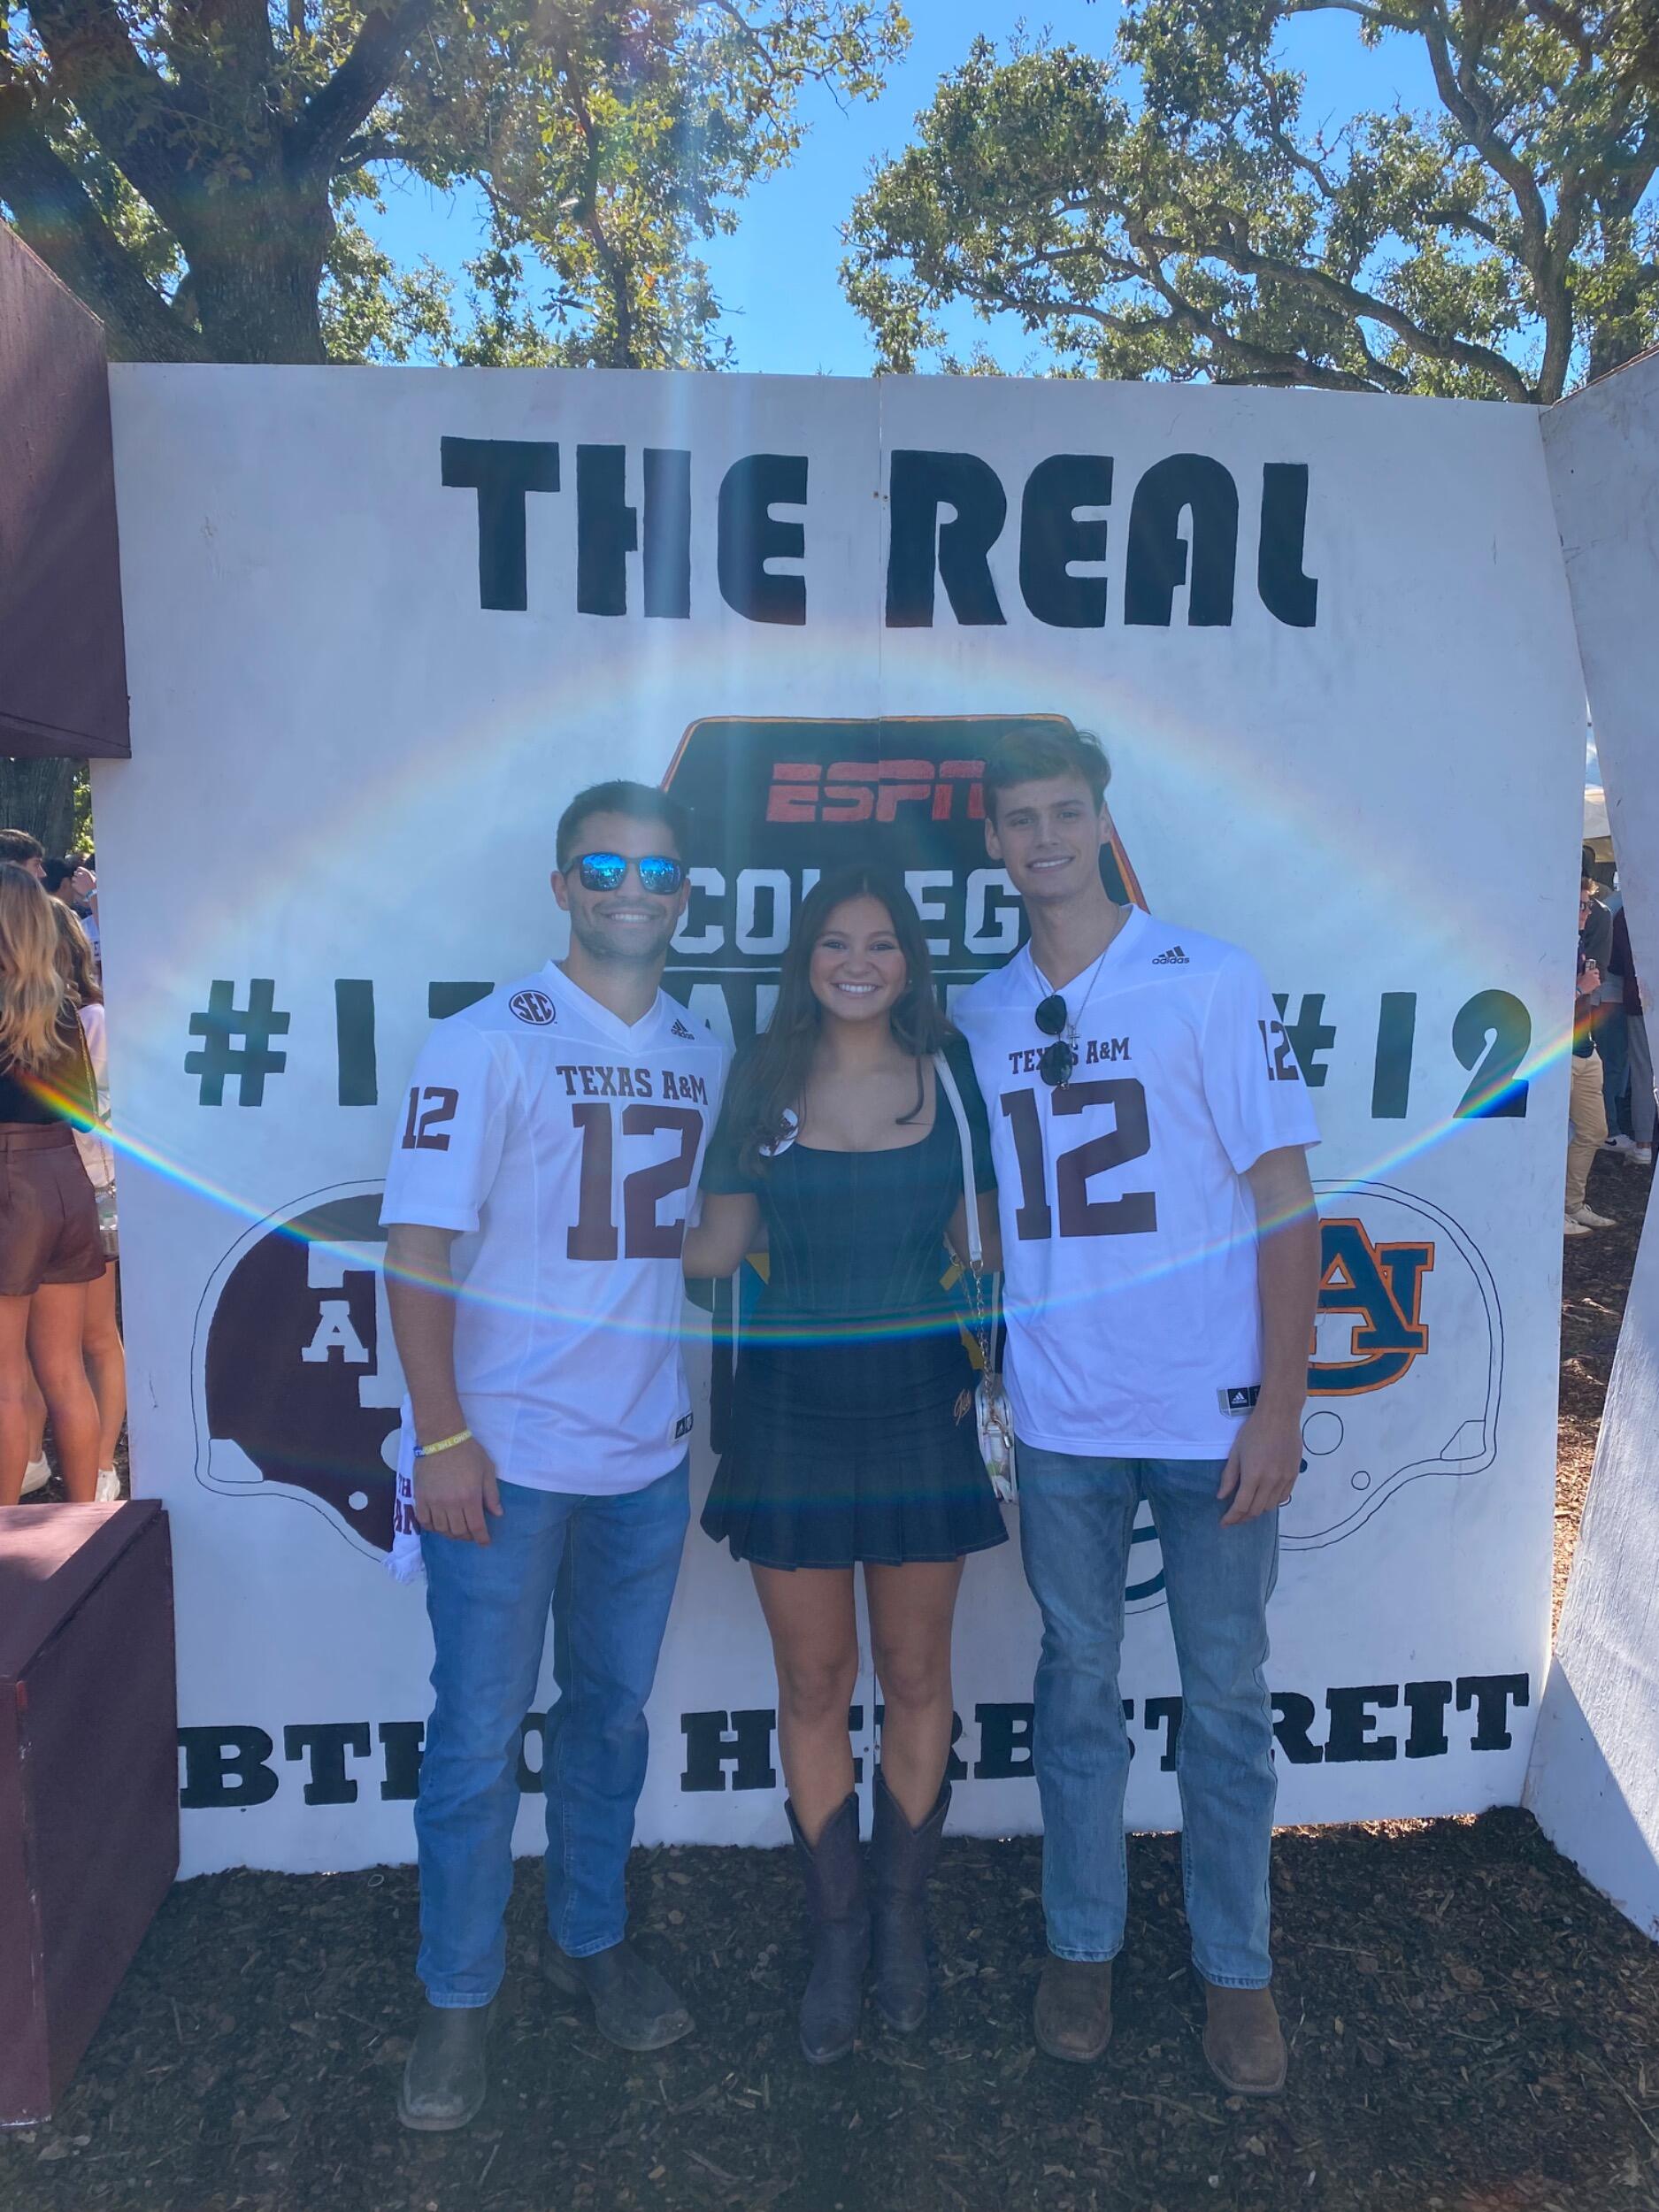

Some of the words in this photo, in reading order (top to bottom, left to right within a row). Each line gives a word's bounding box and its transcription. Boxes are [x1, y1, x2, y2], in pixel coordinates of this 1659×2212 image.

[441, 435, 809, 626] THE
[885, 449, 1318, 627] REAL
[766, 758, 986, 822] ESPN
[669, 868, 1023, 955] COEG
[511, 990, 554, 1025] SEC
[1086, 1036, 1132, 1064] A&M
[1257, 1019, 1300, 1081] 12
[556, 1065, 653, 1098] TEXAS
[661, 1069, 709, 1106] A&M
[401, 1086, 460, 1152] 12
[566, 1102, 704, 1262] 12
[1000, 1077, 1157, 1240] 12
